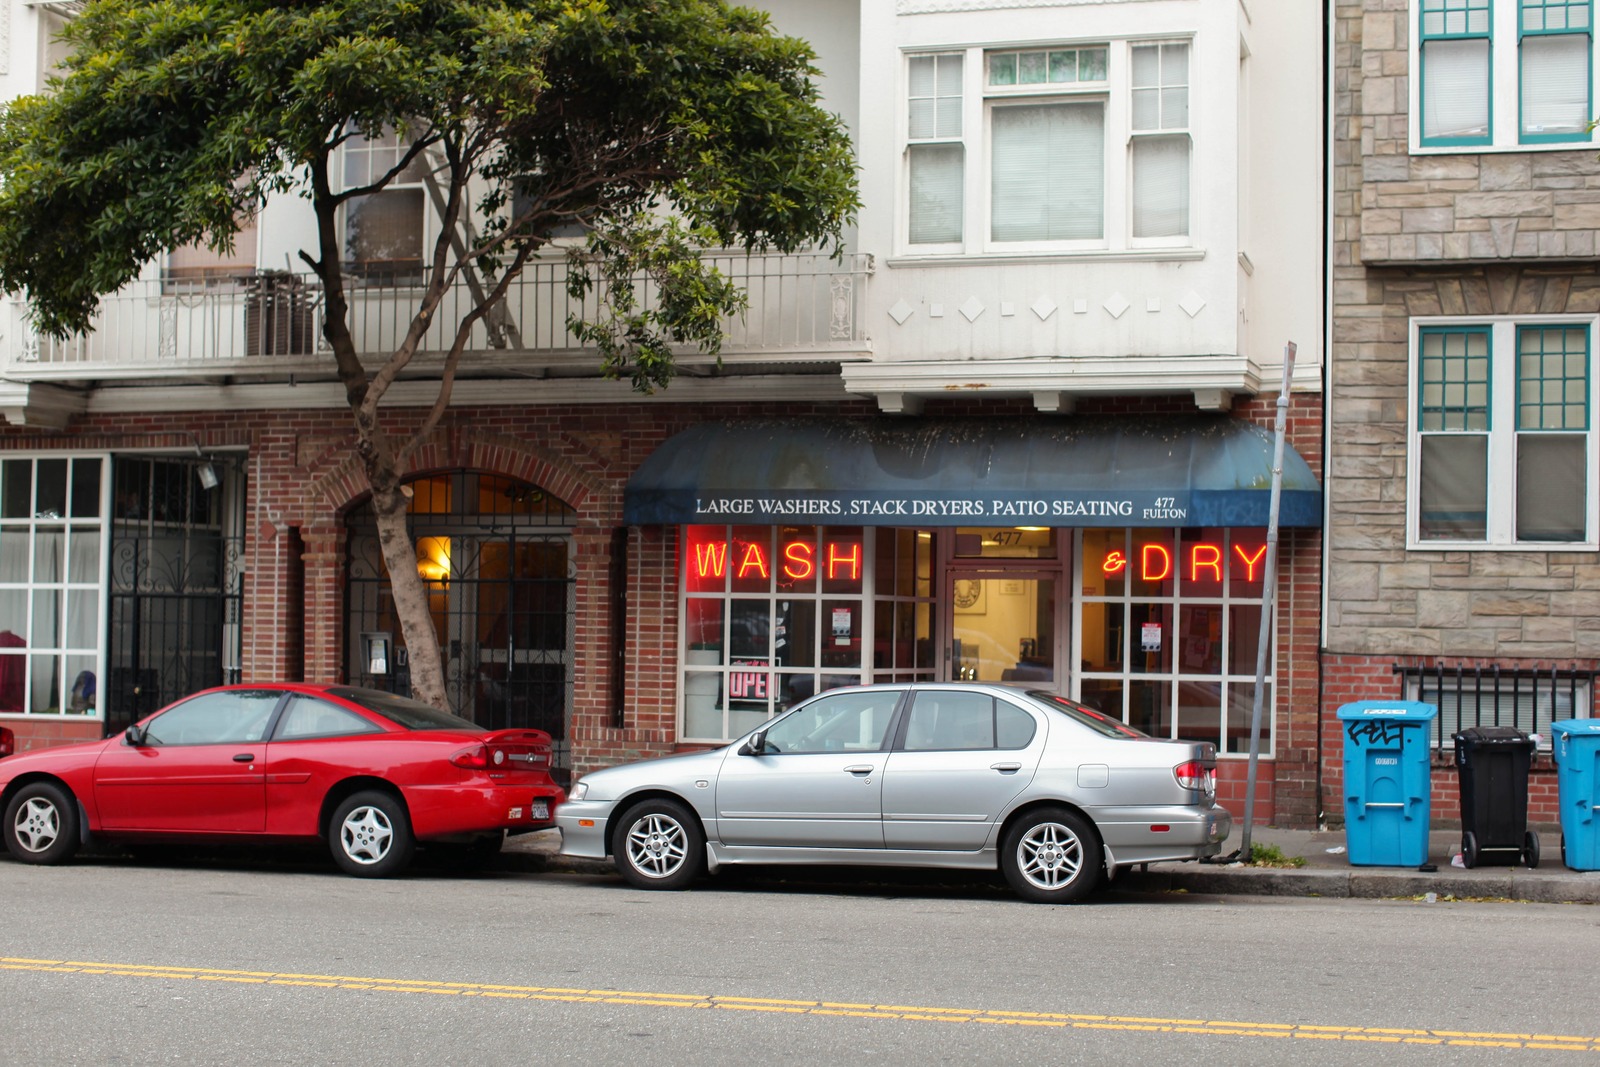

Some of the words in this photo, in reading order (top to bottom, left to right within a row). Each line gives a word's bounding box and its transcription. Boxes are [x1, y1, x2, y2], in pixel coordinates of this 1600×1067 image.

[695, 498, 754, 514] LARGE
[850, 499, 908, 516] STACK
[992, 500, 1048, 516] PATIO
[1052, 500, 1133, 516] SEATING
[1154, 497, 1175, 508] 477
[1143, 508, 1187, 519] FULTON
[992, 531, 1023, 546] 477
[694, 542, 859, 580] WASH
[1102, 551, 1127, 572] &
[1142, 543, 1267, 582] DRY
